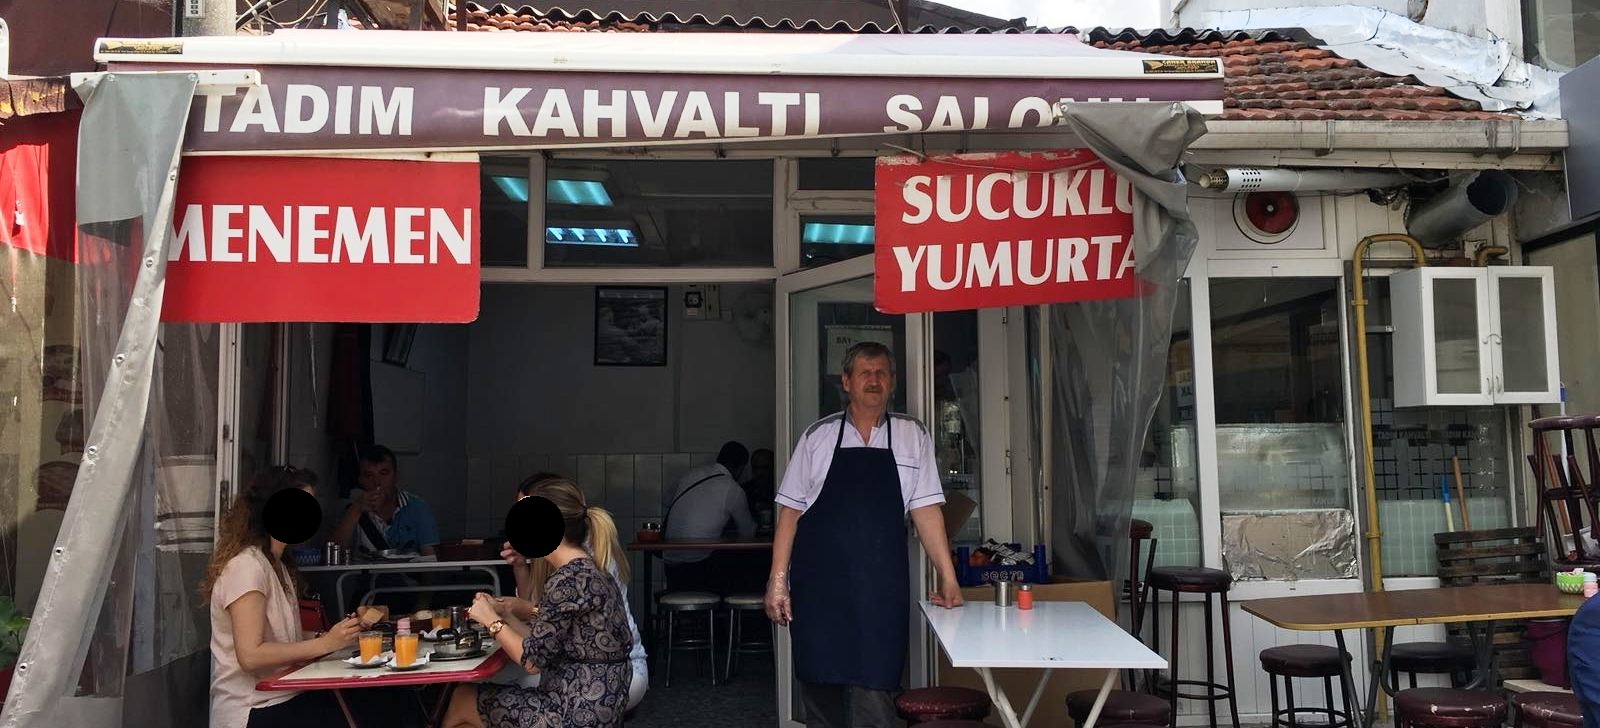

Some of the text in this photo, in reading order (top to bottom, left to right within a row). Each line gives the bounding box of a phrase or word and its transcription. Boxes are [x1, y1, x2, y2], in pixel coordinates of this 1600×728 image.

[194, 84, 1150, 138] TADIM KAHVALTI SALO
[168, 204, 472, 265] MENEMEN
